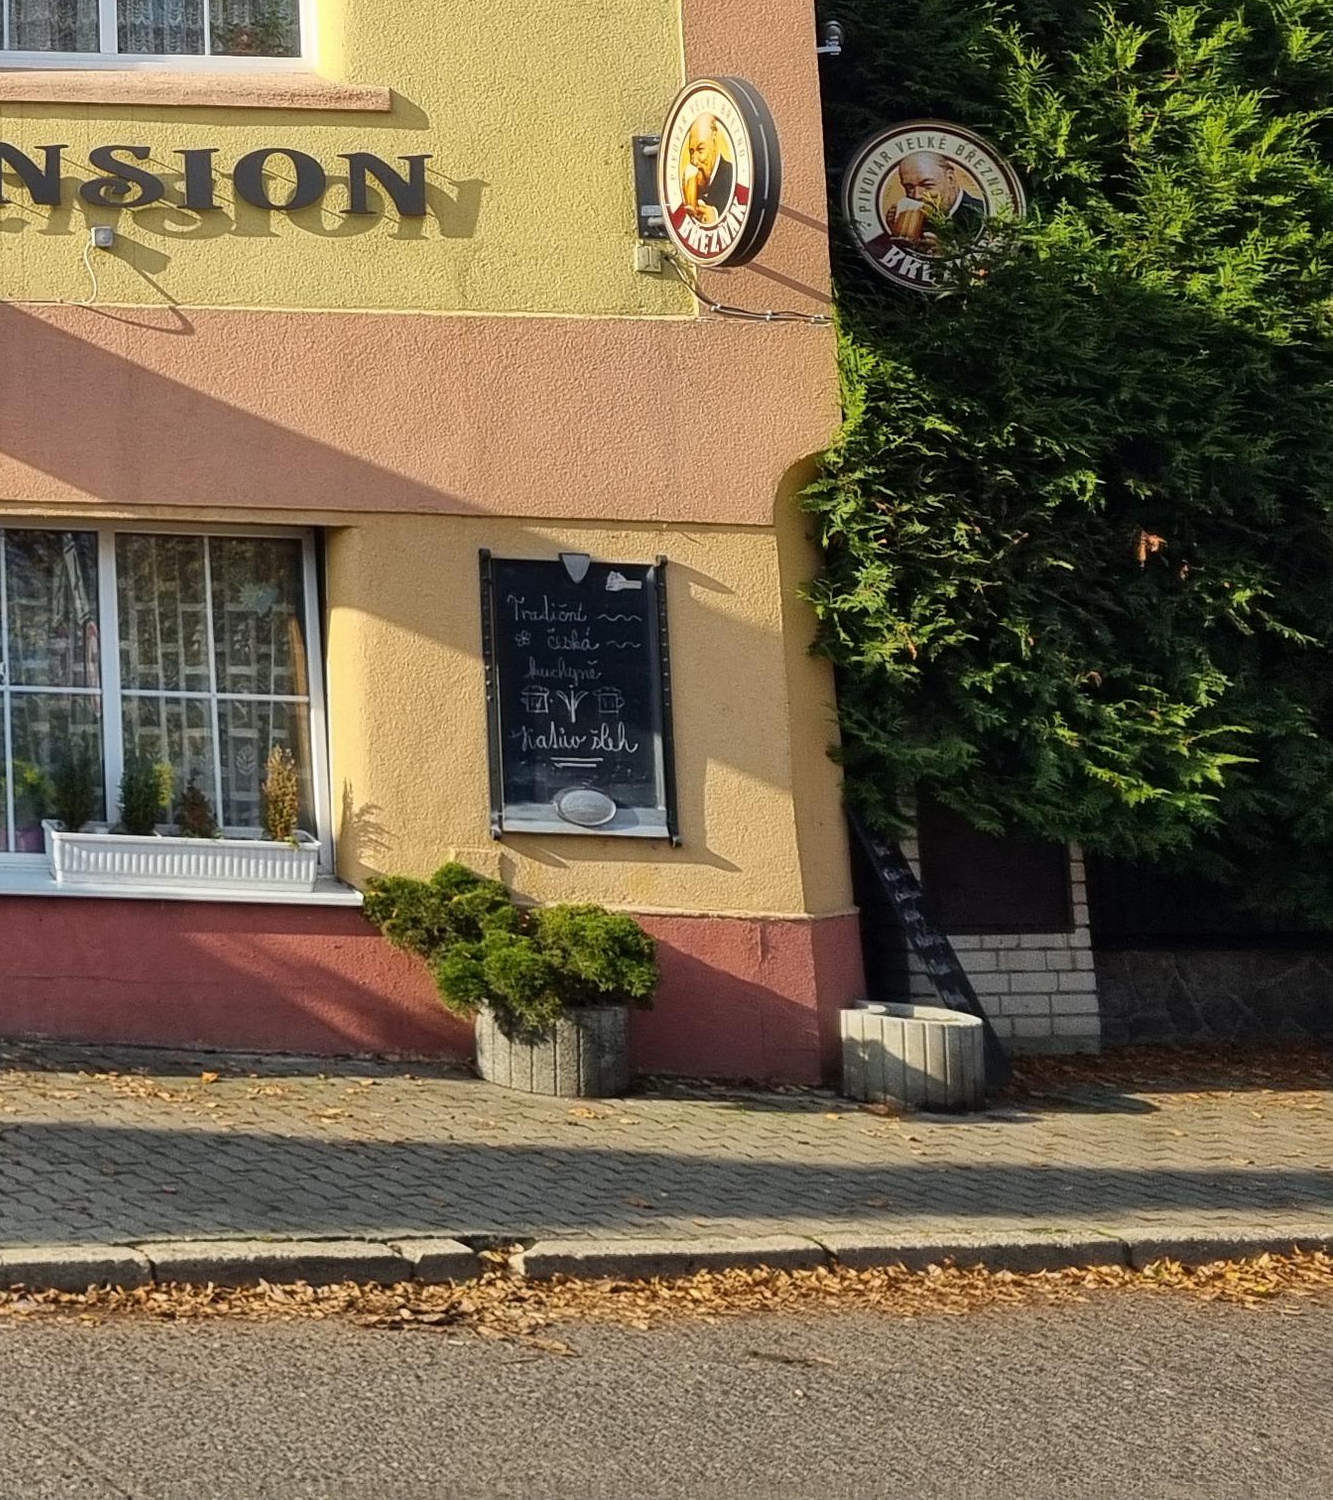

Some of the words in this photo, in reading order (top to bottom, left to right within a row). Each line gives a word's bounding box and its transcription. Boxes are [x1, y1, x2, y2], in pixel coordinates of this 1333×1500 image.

[859, 151, 893, 213] PIVOVAR
[895, 135, 947, 153] VELKÉ
[954, 142, 1004, 197] BŘEZNO
[590, 721, 639, 753] šleh
